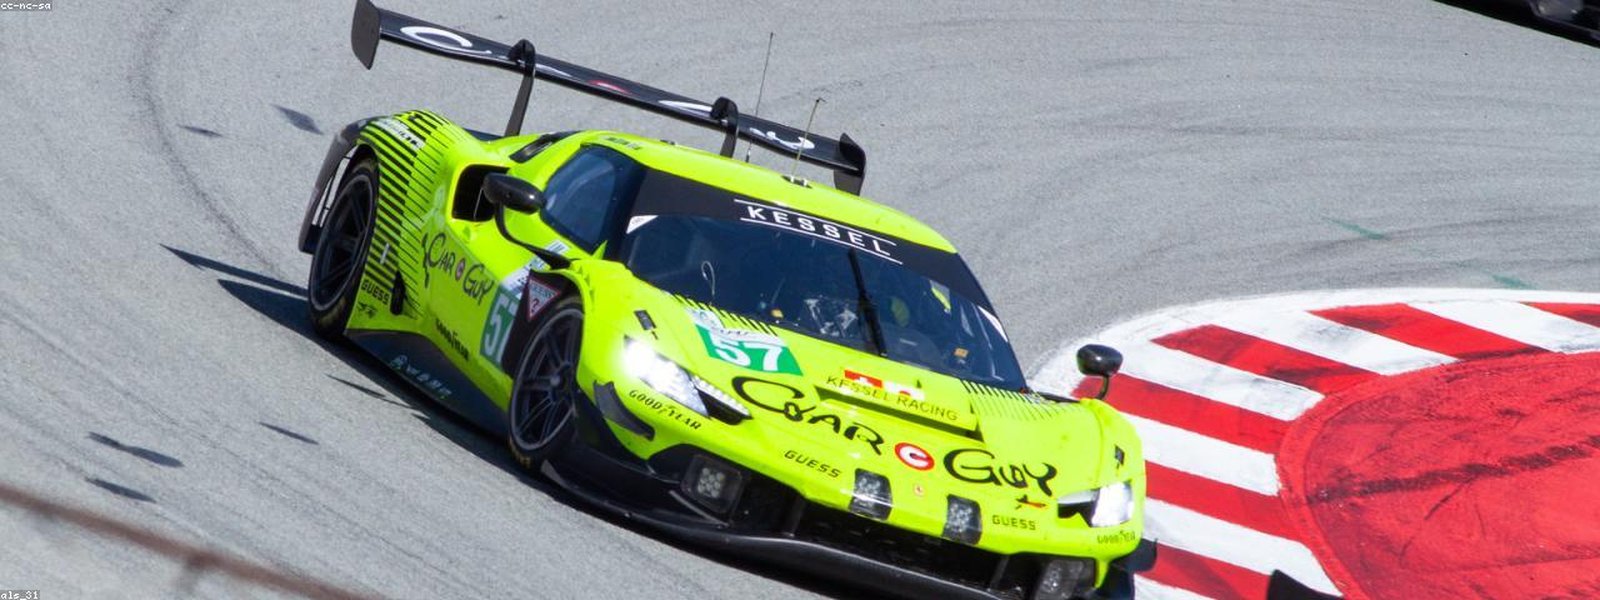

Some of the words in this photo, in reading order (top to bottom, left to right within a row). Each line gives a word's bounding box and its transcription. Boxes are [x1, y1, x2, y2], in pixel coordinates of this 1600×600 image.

[747, 206, 891, 256] KESSEL
[361, 280, 389, 305] GUESS
[711, 335, 783, 372] 57
[827, 376, 889, 401] KESSEL
[897, 396, 958, 421] RACING
[784, 450, 842, 478] GUESS
[943, 448, 1058, 497] GUY
[992, 514, 1036, 531] GUESS
